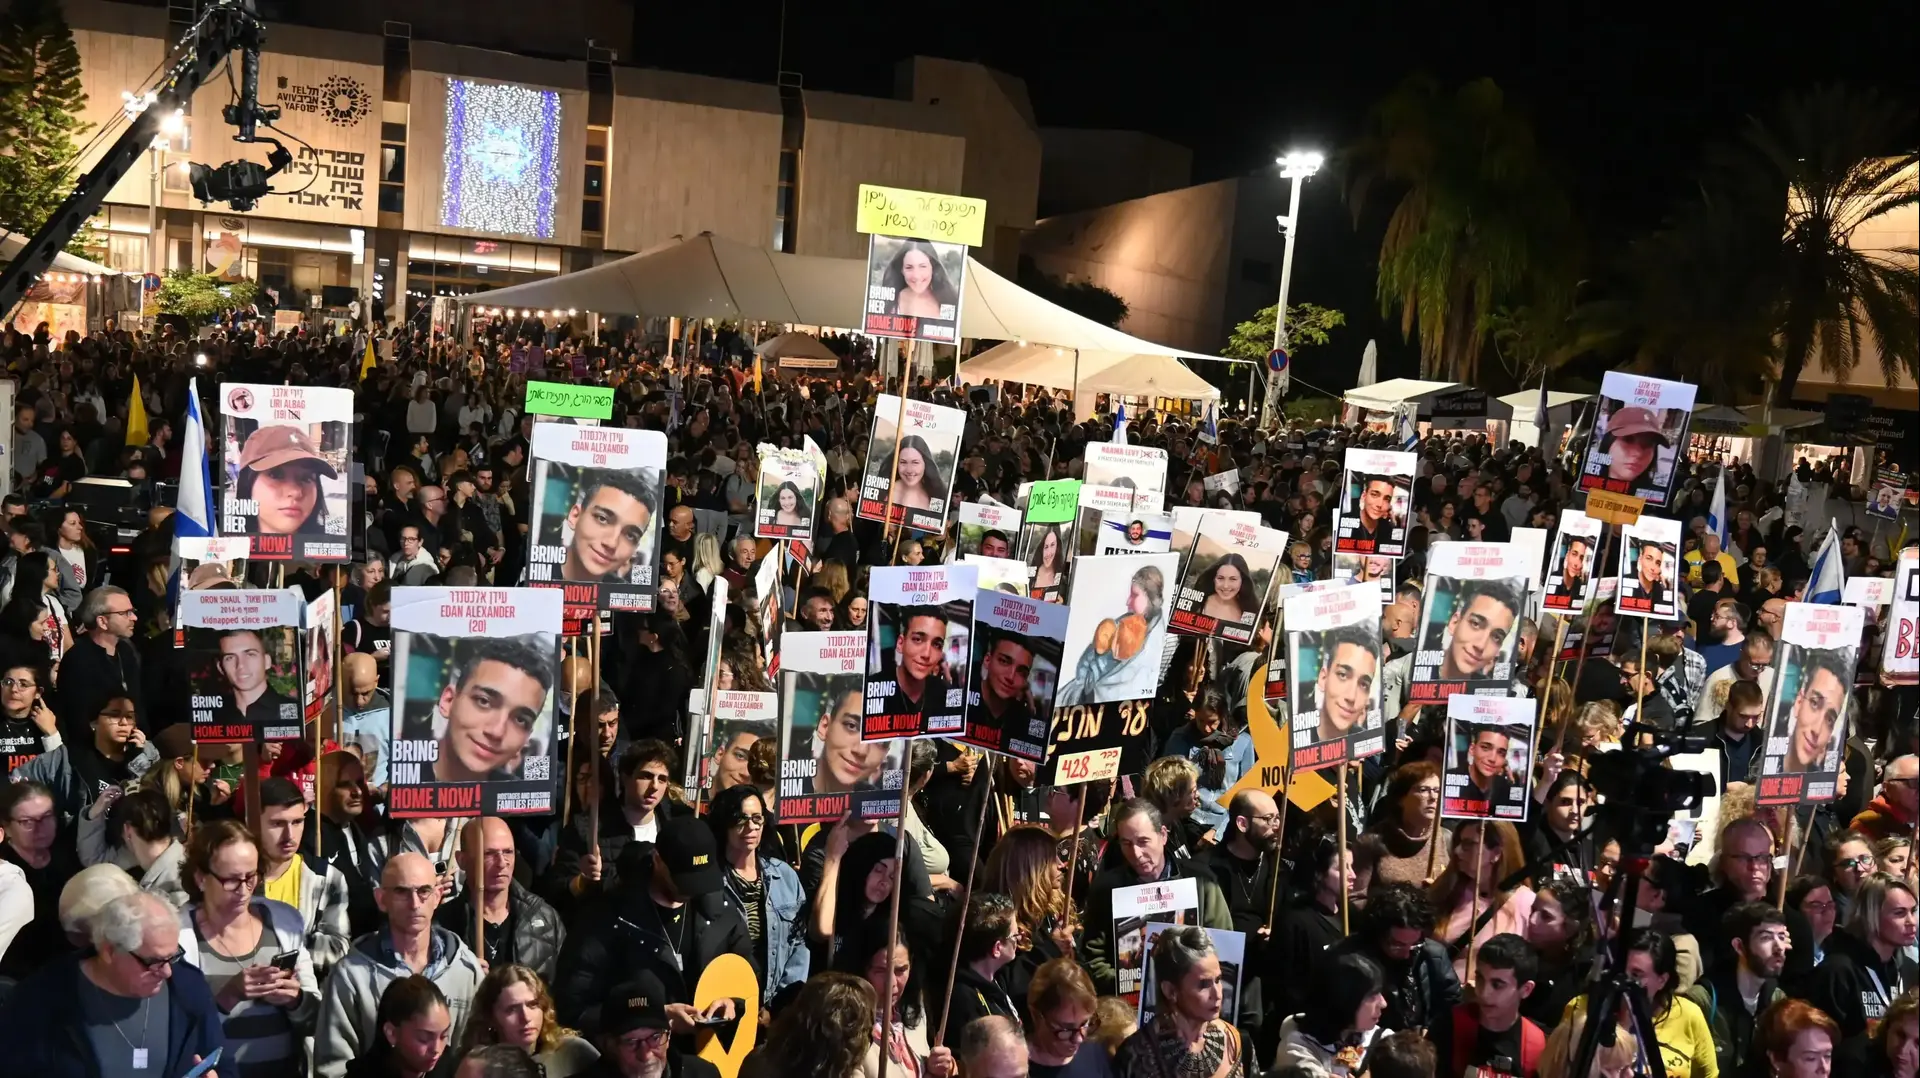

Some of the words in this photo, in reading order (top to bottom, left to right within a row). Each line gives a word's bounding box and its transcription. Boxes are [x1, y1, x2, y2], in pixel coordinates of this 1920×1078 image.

[292, 85, 307, 95] TEL
[307, 85, 319, 96] תל
[277, 93, 297, 103] AVIV
[296, 95, 319, 105] אביב
[285, 102, 305, 112] YAFO
[306, 103, 319, 113] יפו
[298, 146, 365, 166] ספריית
[315, 163, 364, 181] שער
[330, 180, 363, 195] בית
[289, 191, 362, 210] אריאלה
[869, 285, 896, 301] BRING
[868, 299, 886, 315] HER
[867, 314, 891, 329] HOME
[272, 387, 289, 398] אלבג
[289, 388, 304, 398] לירי
[270, 399, 282, 409] LIRI
[284, 400, 305, 409] ALBAG
[274, 410, 287, 420] (19)
[610, 431, 624, 442] עידן
[571, 441, 590, 451] EDAN
[591, 443, 629, 454] ALEXANDER
[1101, 446, 1123, 456] NAAMA
[1124, 448, 1139, 457] LEVY
[592, 454, 607, 465] (20)
[1589, 451, 1612, 465] BRING
[1585, 463, 1601, 476] HER
[866, 475, 890, 490] BRING
[864, 487, 880, 500] HER
[223, 498, 259, 516] BRING
[861, 500, 883, 516] HOME
[223, 516, 246, 533] HER
[258, 535, 293, 553] NOW!
[530, 545, 566, 564] BRING
[529, 563, 552, 581] HIM
[564, 583, 598, 603] NOW!
[902, 582, 918, 592] EDAN
[919, 581, 948, 591] ALEXANDER
[200, 595, 218, 604] ORON
[219, 595, 241, 604] SHAUL
[450, 591, 487, 604] אלכסנדר
[489, 591, 508, 604] עידן
[911, 594, 929, 603] (20)
[1180, 587, 1205, 602] BRING
[1177, 598, 1193, 611] HER
[440, 605, 463, 618] EDAN
[466, 605, 515, 619] ALEXANDER
[993, 606, 1008, 617] EDAN
[1008, 609, 1040, 625] ALEXANDER
[202, 615, 239, 625] kidnapped
[242, 616, 260, 624] since
[263, 616, 278, 624] 2014
[468, 619, 487, 633] (20)
[1001, 619, 1017, 630] (20)
[1174, 611, 1195, 626] HOME
[1195, 615, 1218, 631] NOW!
[827, 636, 855, 647] אלכסנדר
[819, 649, 838, 659] EDAN
[839, 648, 865, 659] ALEXAN
[1414, 650, 1445, 666] BRING
[841, 659, 855, 671] (20)
[1412, 667, 1432, 681] HIM
[867, 681, 896, 698] BRING
[1410, 683, 1437, 699] HOME
[1438, 681, 1467, 696] NOW!
[191, 695, 223, 709] BRING
[734, 702, 763, 710] ALEXANDER
[866, 698, 884, 714] HIM
[192, 710, 213, 722] HIM
[735, 709, 746, 718] (20)
[1293, 709, 1321, 732] BRING
[866, 714, 891, 732] HOME
[893, 712, 922, 730] NOW!
[194, 725, 224, 738] HOME
[226, 725, 253, 738] NOW!
[975, 725, 1001, 743] NOW!
[1293, 729, 1312, 749] HIM
[391, 739, 439, 763] BRING
[1294, 745, 1319, 768] HOME
[1320, 738, 1346, 762] NOW!
[391, 763, 421, 785] HIM
[781, 759, 817, 777] BRING
[1062, 755, 1091, 779] 428
[1446, 774, 1469, 786] BRING
[780, 778, 803, 797] HIM
[1445, 786, 1460, 797] HIM
[391, 787, 434, 809] HOME
[438, 784, 481, 809] NOW!
[497, 800, 526, 810] FAMILIES
[527, 799, 550, 809] FORUM
[780, 797, 812, 816] HOME
[816, 794, 850, 816] NOW!
[861, 806, 883, 815] FAMILIES
[1119, 967, 1141, 982] BRING
[1119, 980, 1134, 994] HIM
